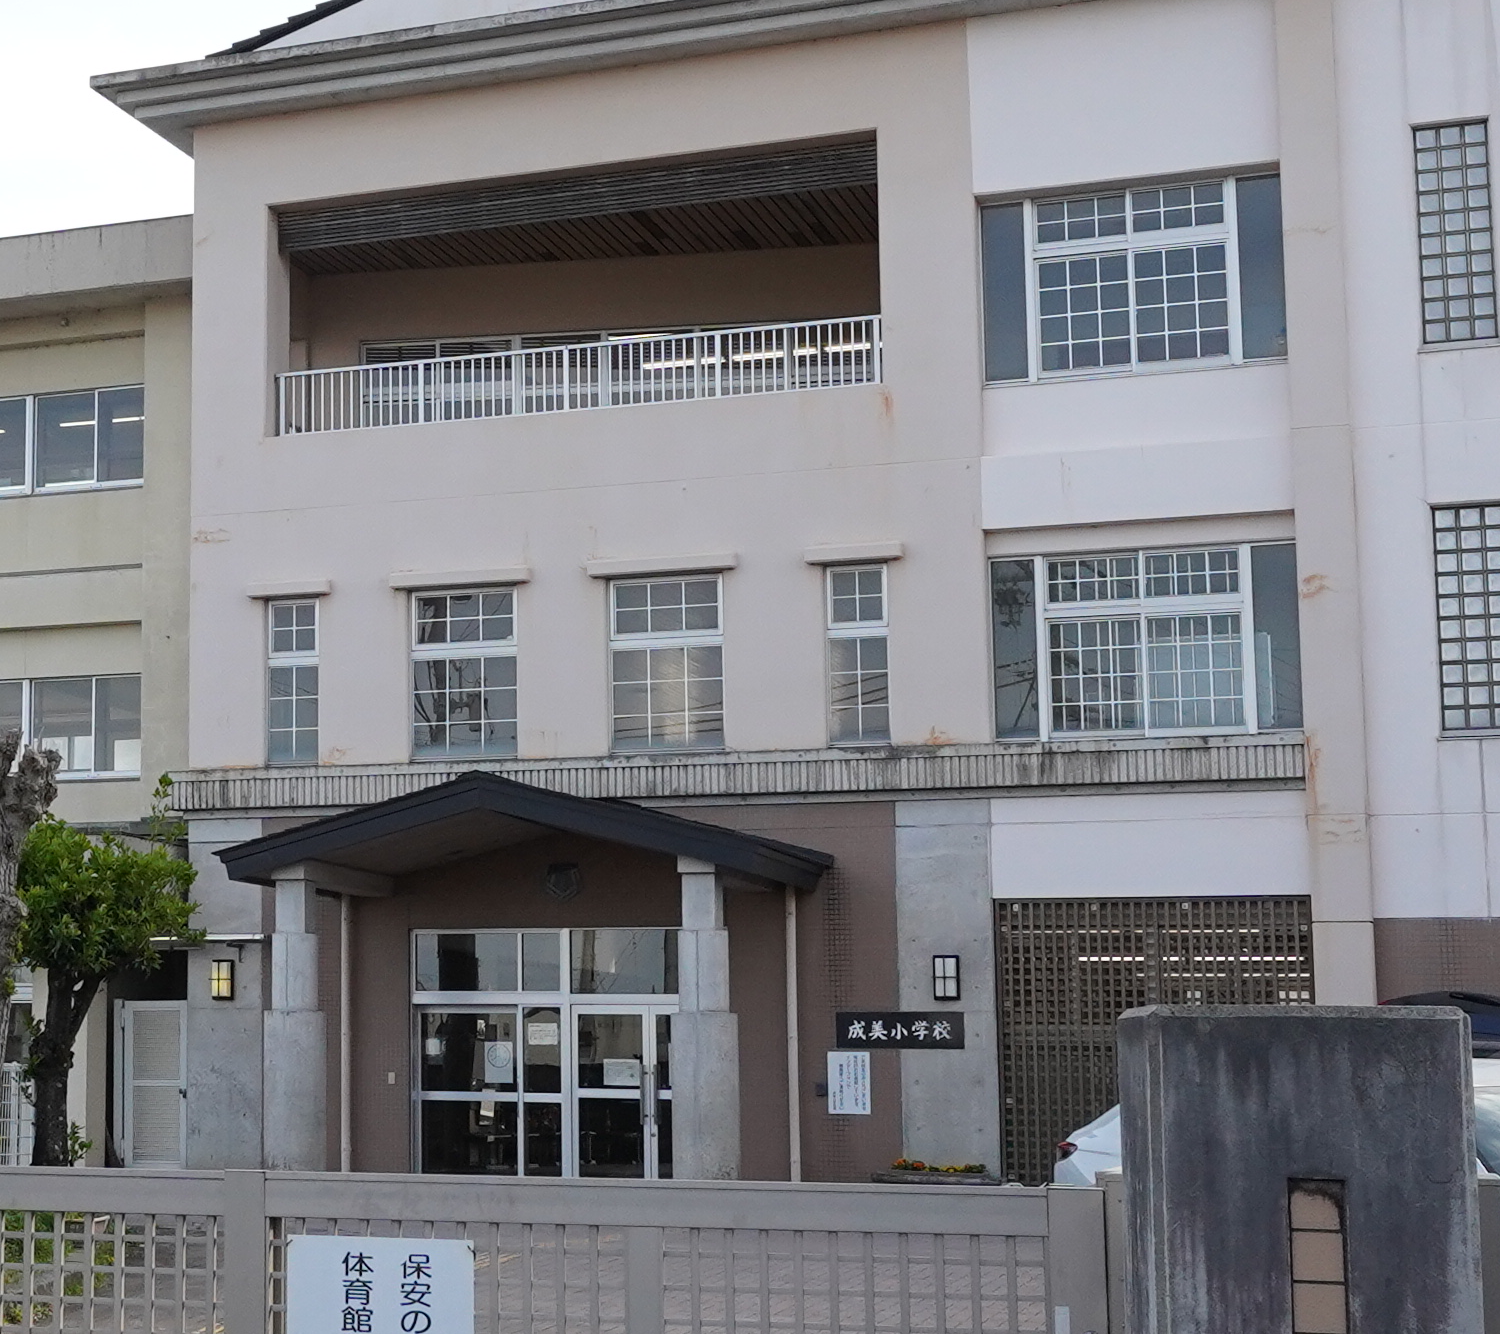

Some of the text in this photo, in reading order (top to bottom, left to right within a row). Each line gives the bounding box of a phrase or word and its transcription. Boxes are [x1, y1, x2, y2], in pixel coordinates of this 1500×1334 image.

[847, 1019, 953, 1041] 成美小学校
